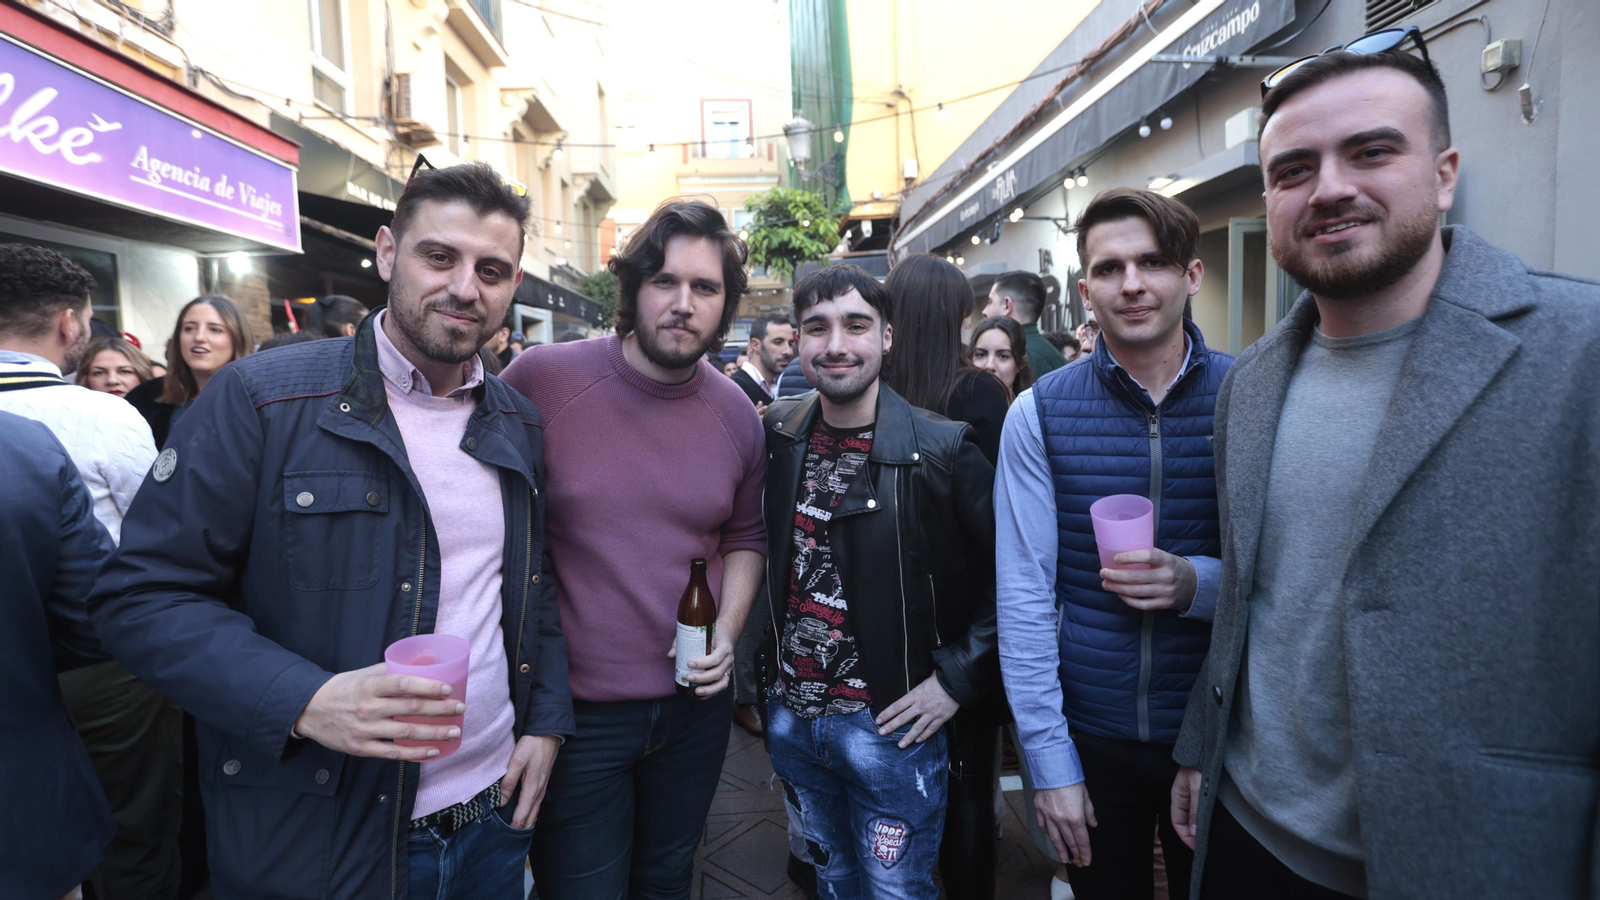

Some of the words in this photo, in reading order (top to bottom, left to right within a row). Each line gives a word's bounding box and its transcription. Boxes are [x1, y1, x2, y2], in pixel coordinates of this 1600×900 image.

[1182, 1, 1260, 69] Cruzcampo
[130, 145, 211, 184] Agencia
[213, 173, 235, 200] de
[237, 181, 283, 219] Viajes
[799, 597, 834, 620] Straight
[832, 609, 845, 627] Up
